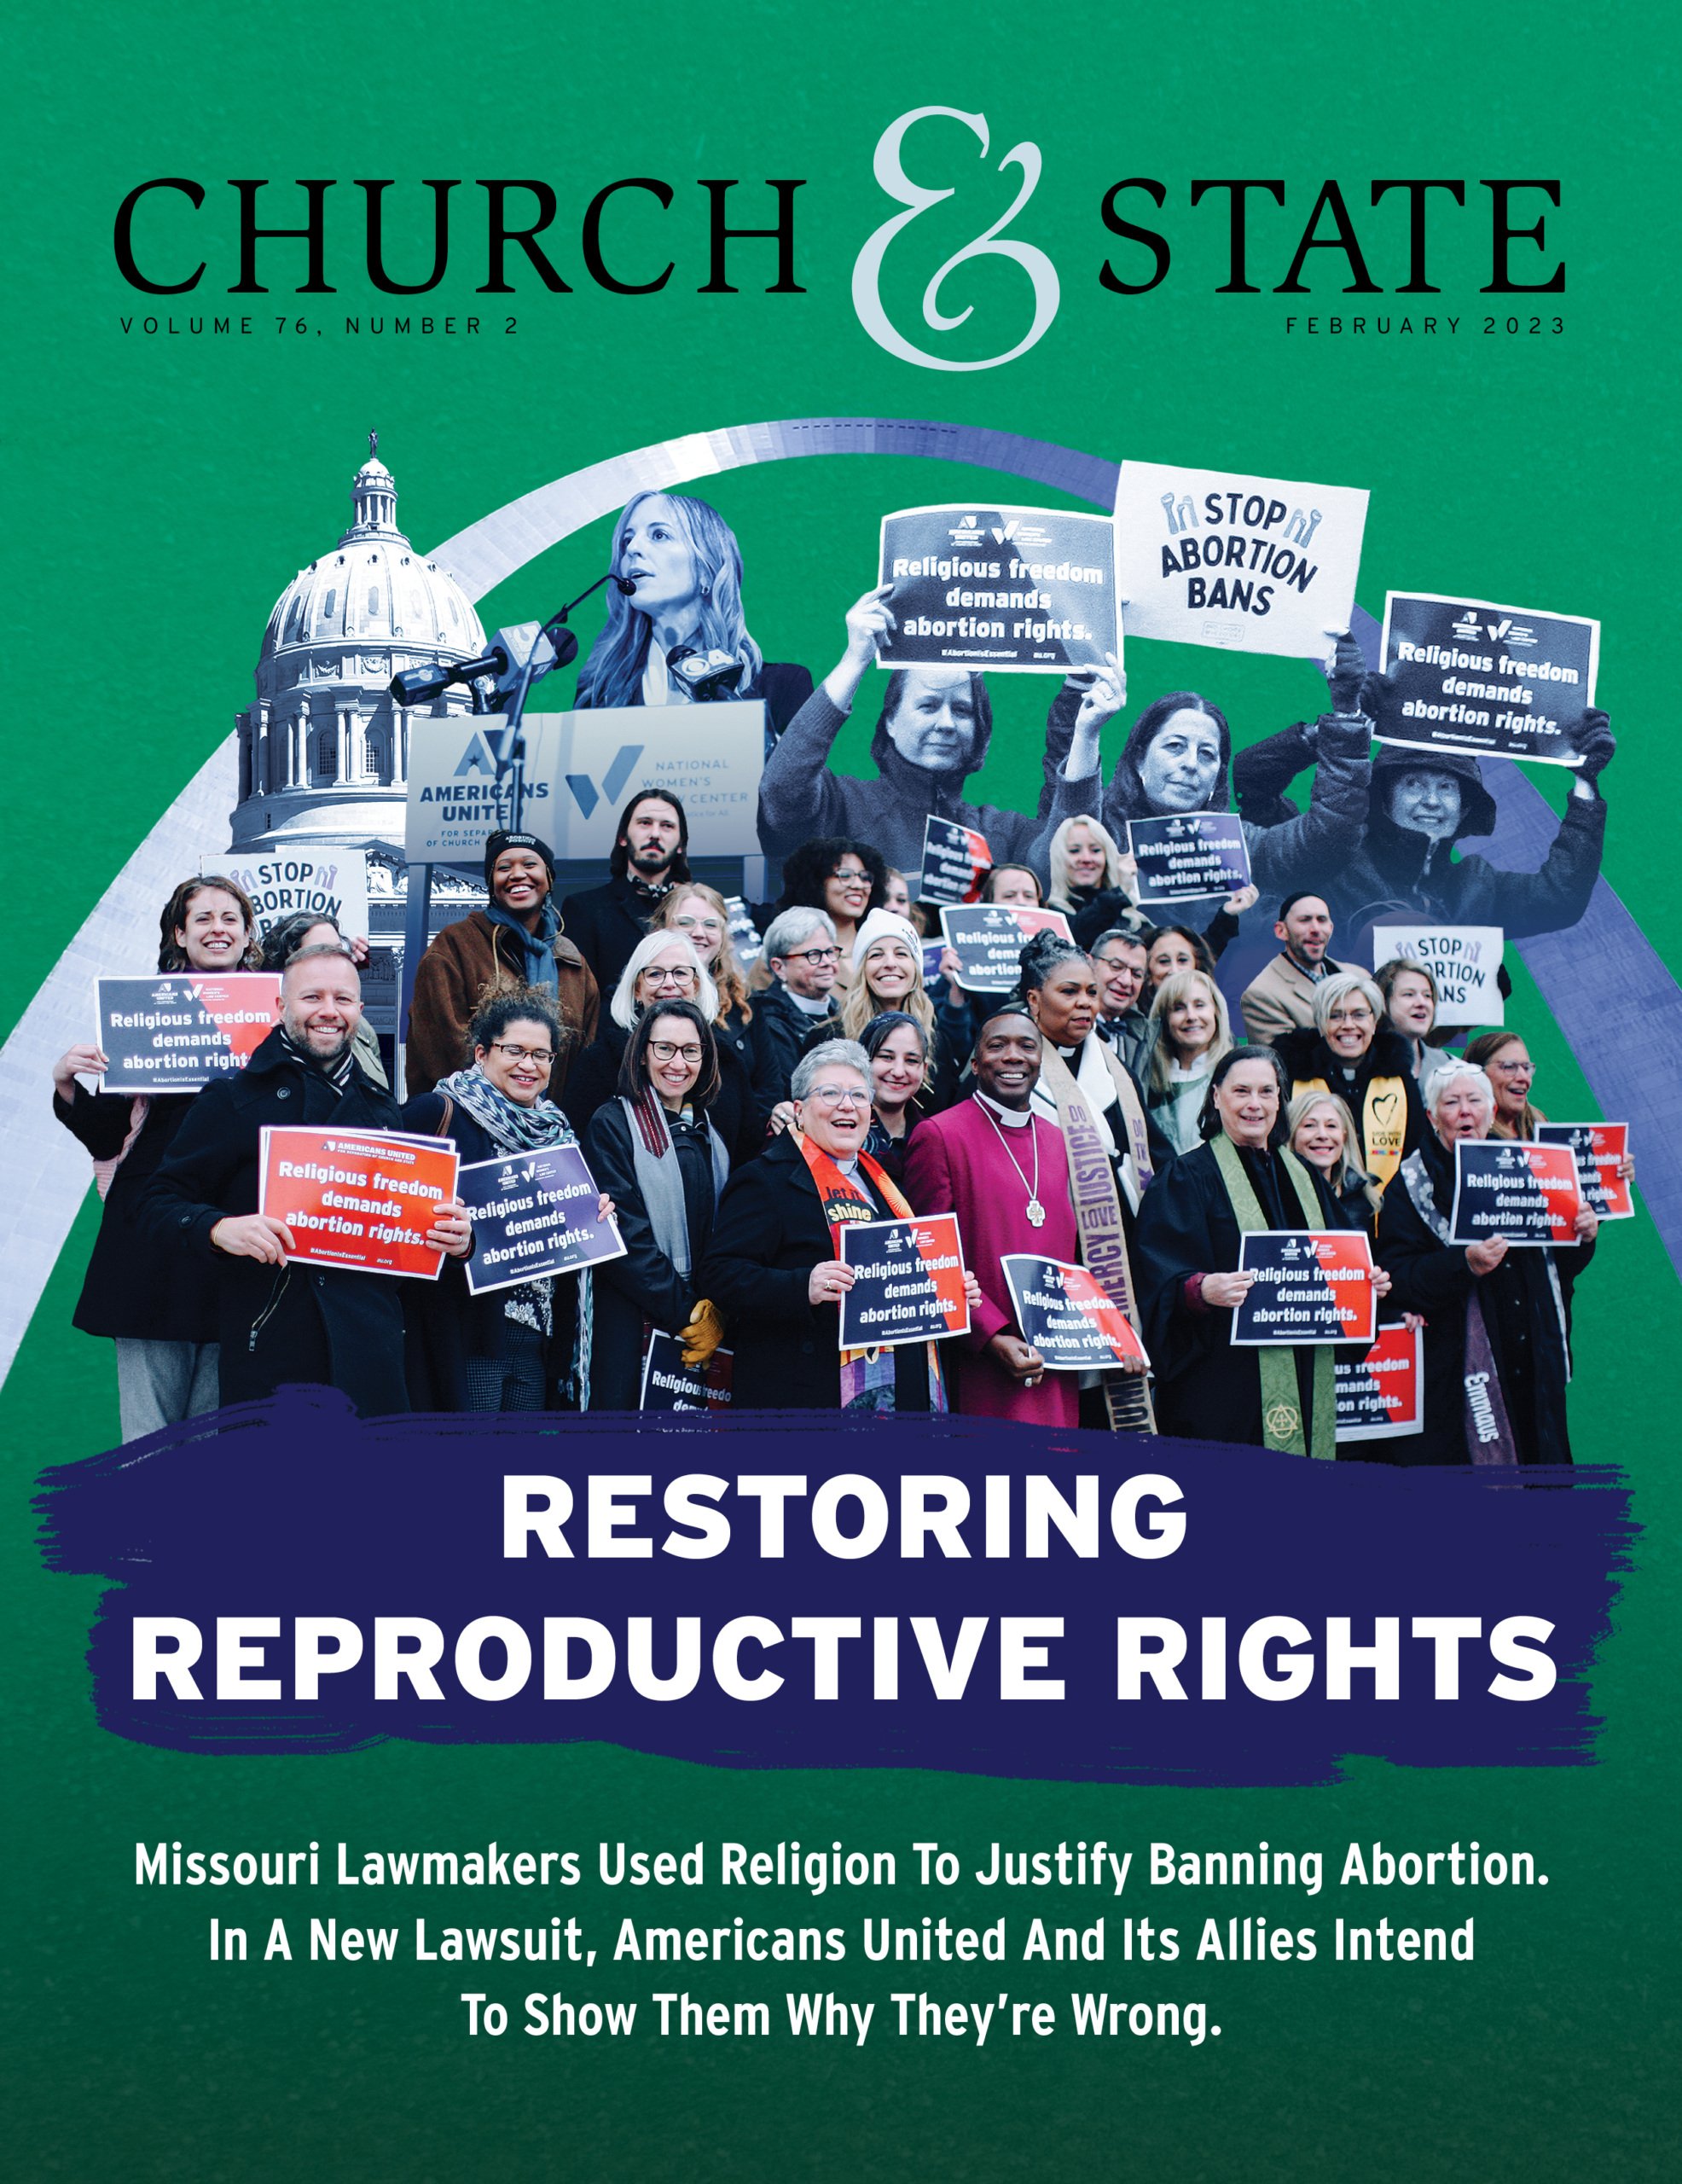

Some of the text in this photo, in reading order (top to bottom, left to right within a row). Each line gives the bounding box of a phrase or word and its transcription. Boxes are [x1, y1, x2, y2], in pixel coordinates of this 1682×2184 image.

[1205, 492, 1287, 530] STOP
[893, 556, 1103, 584] Religious freedom
[1161, 536, 1319, 593] ABORTION
[947, 588, 1051, 608] demands
[1187, 577, 1275, 616] BANS
[903, 616, 1092, 642] abortion rights.
[1398, 642, 1579, 684] Religious freedom
[1442, 677, 1533, 705] demands
[1401, 700, 1562, 735] abortion rights.
[656, 760, 728, 770] NATIONAL
[641, 776, 711, 787] WOMEN'S
[420, 782, 548, 803] AMERICANS
[690, 793, 748, 804] CENTER
[443, 804, 523, 822] UNITE
[1139, 838, 1241, 857] Religious freedom
[1169, 854, 1221, 870] demands
[258, 862, 313, 884] STOP
[1148, 868, 1243, 887] abortion rights.
[252, 889, 341, 917] BORTION
[956, 931, 1015, 946] Religious
[1418, 938, 1462, 956] STOP
[111, 1010, 270, 1029] Religious freedom
[153, 1031, 231, 1048] demands
[124, 1053, 251, 1070] abortion right
[1068, 1105, 1088, 1123] DO
[338, 1142, 415, 1160] AMERICANS UNITED
[1372, 1137, 1401, 1146] LOVE
[1067, 1122, 1117, 1206] JUSTICE
[279, 1161, 443, 1200] Religious freedom
[1467, 1174, 1573, 1190] Religious freedom
[1580, 1170, 1602, 1183] ands
[537, 1182, 592, 1205] freedom
[1496, 1194, 1549, 1208] demands
[322, 1191, 402, 1217] demands
[828, 1203, 871, 1222] shine
[505, 1210, 566, 1236] demands
[1081, 1205, 1118, 1230] LOVE
[1472, 1211, 1567, 1228] abortion rights.
[286, 1211, 426, 1246] abortion rights.
[483, 1228, 594, 1265] abortion rights.
[855, 1254, 959, 1280] Religious freedom
[1250, 1266, 1365, 1284] Religious freedom
[885, 1278, 937, 1298] demands
[1277, 1288, 1337, 1302] demands
[1023, 1290, 1064, 1310] Religious
[860, 1297, 956, 1323] abortion rights.
[1253, 1307, 1357, 1324] abortion rights.
[1047, 1314, 1097, 1329] demands
[1034, 1333, 1122, 1349] abortion rights.
[1336, 1379, 1380, 1393] mands
[1358, 1395, 1403, 1412] rights.
[1464, 1371, 1499, 1443] Emmaus
